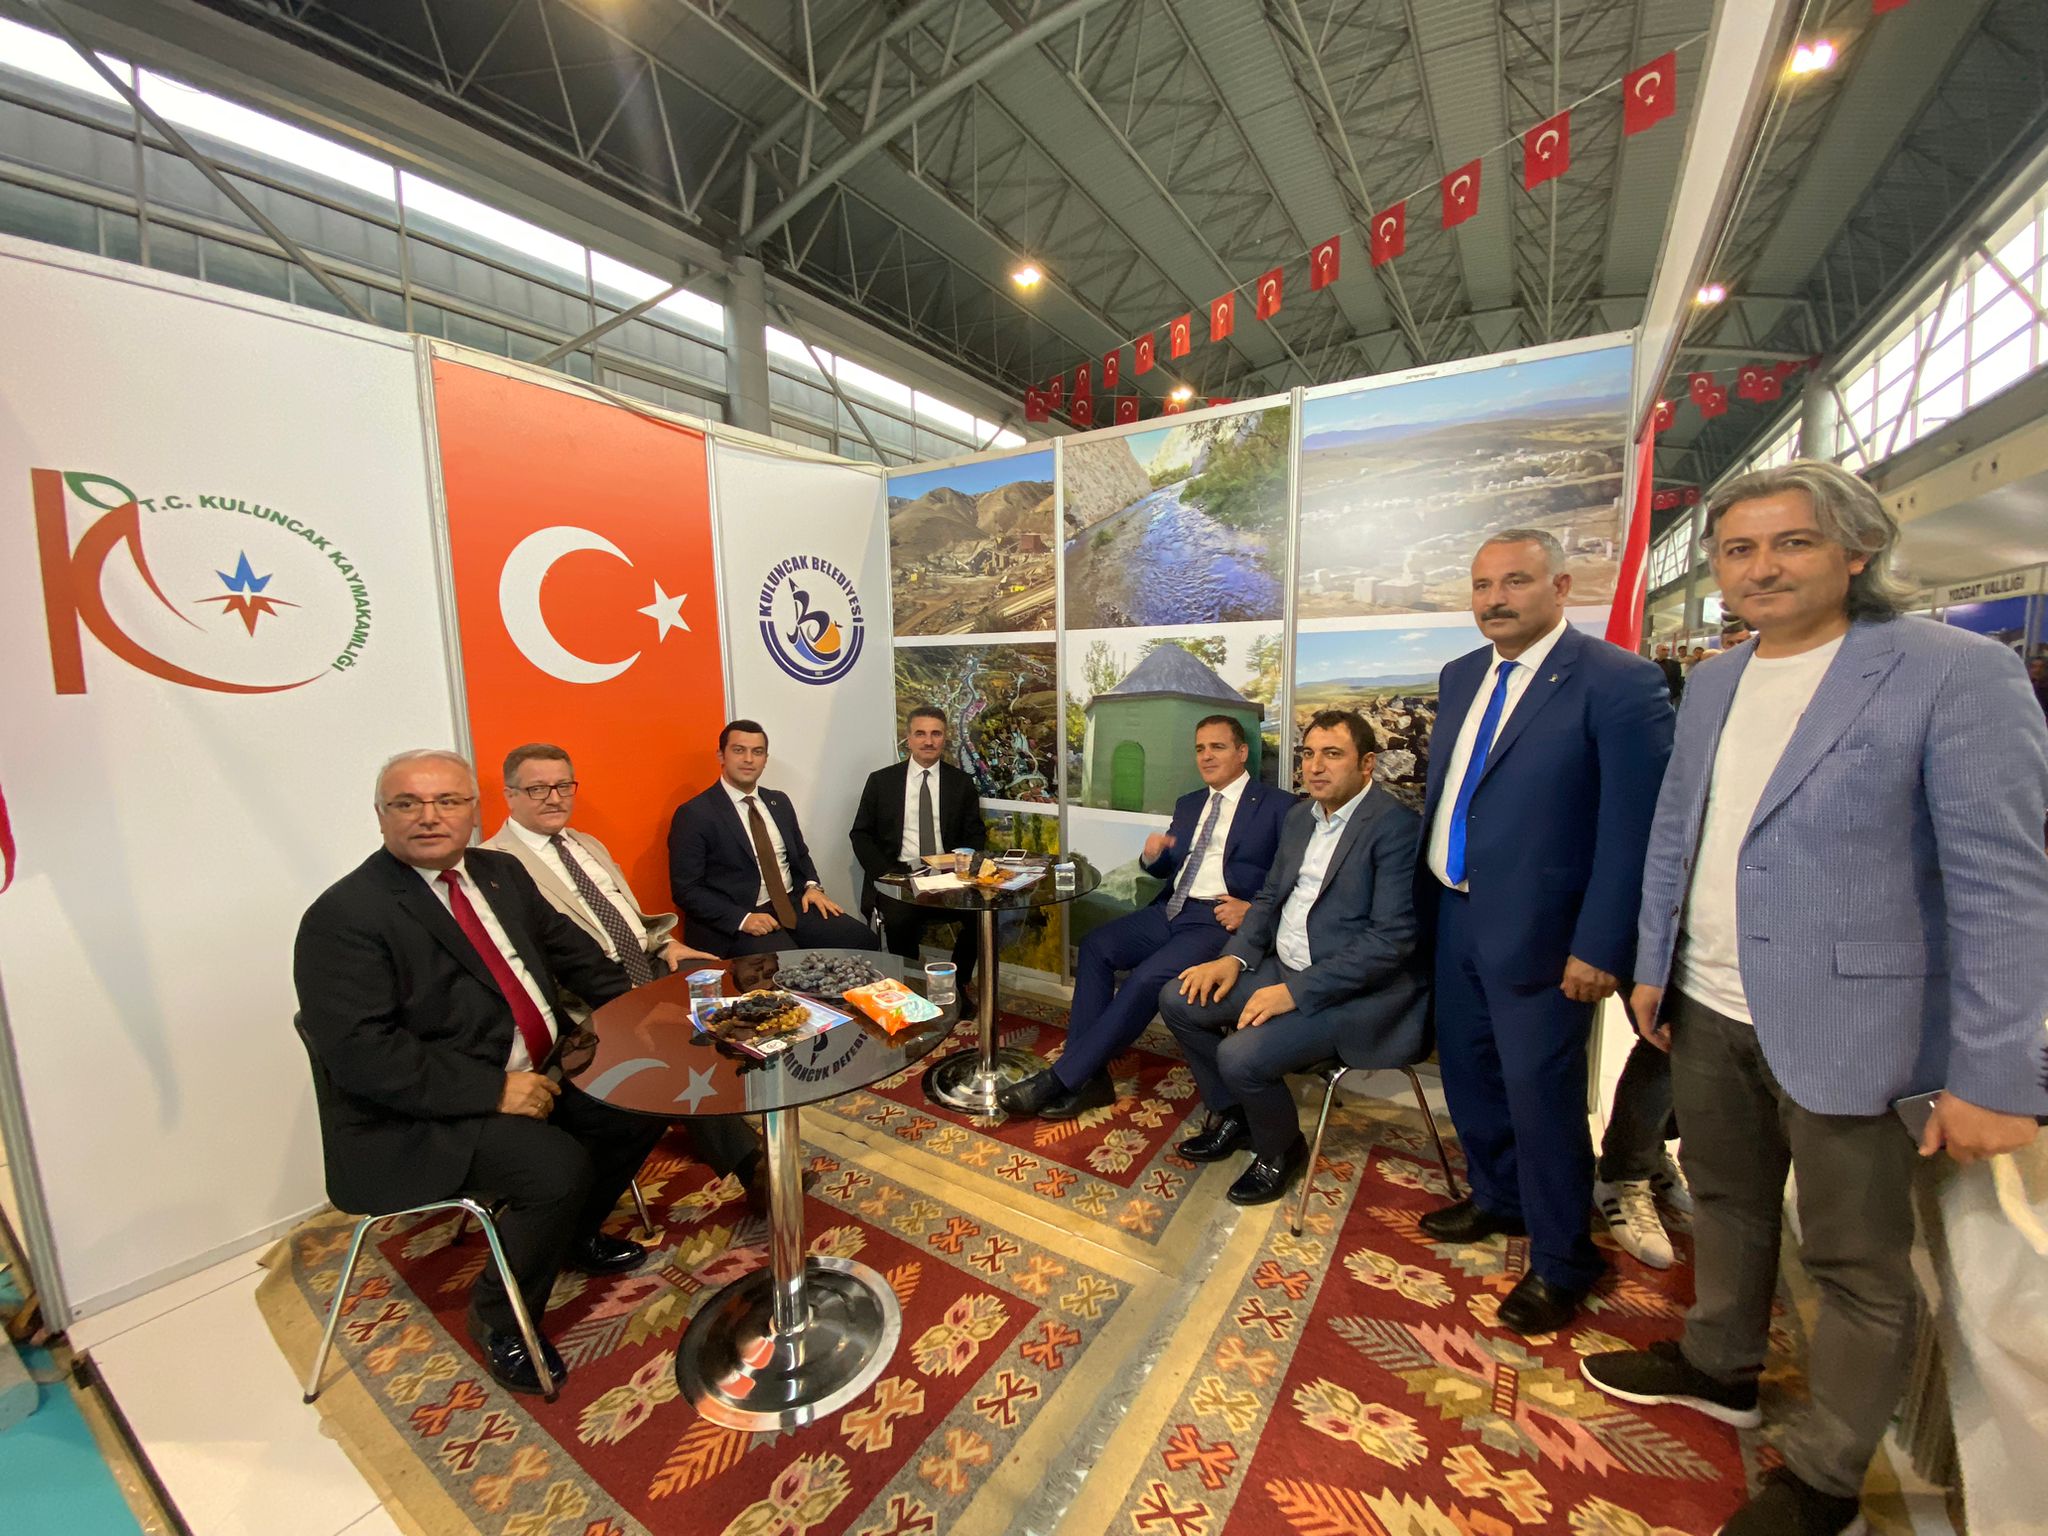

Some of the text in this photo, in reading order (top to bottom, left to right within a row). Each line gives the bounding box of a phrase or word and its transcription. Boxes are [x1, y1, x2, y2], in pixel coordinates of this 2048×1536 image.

[138, 494, 372, 672] T.C. KULUNCAK KAYMAKAMLIĞI
[759, 555, 809, 617] KULUNCAK
